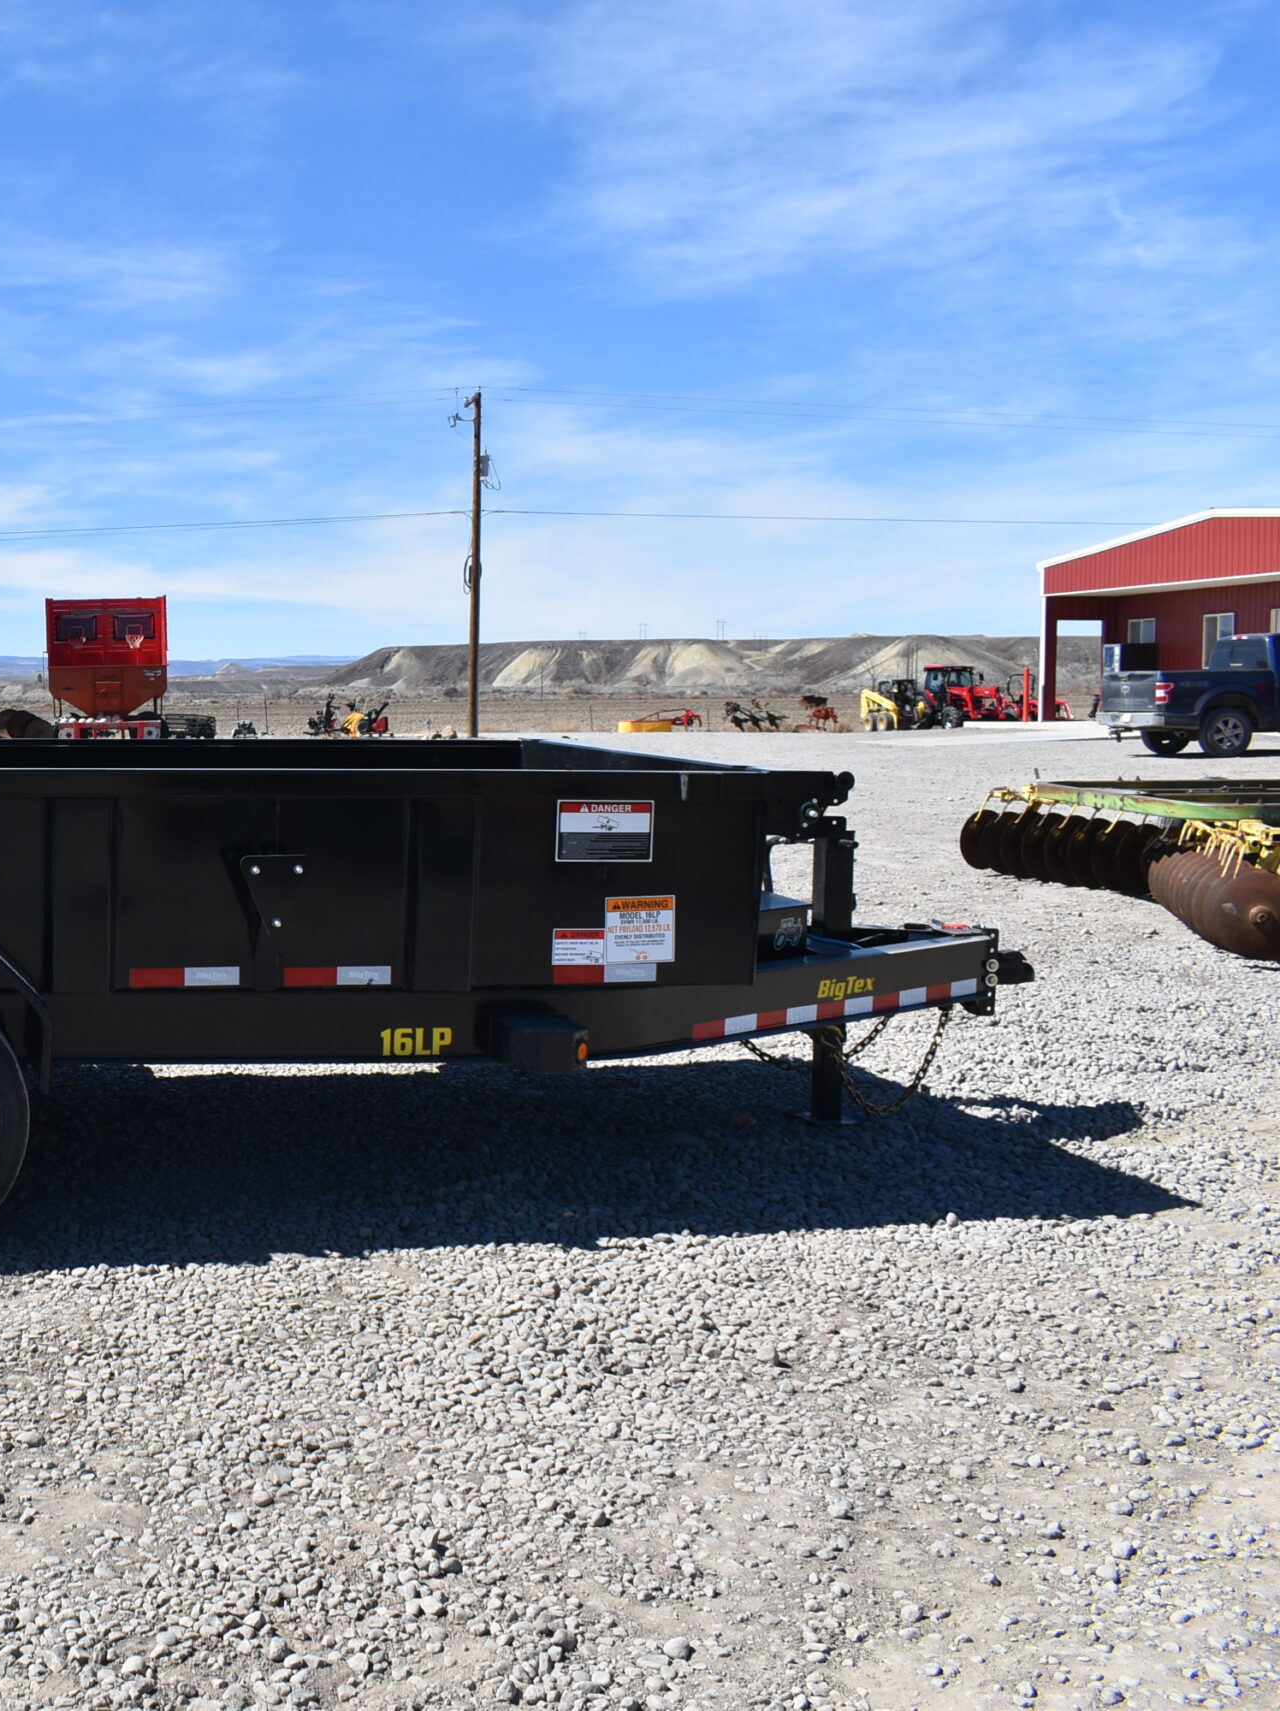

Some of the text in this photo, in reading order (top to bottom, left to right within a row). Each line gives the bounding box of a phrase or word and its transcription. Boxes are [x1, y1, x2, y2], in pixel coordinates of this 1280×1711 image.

[591, 804, 632, 812] DANGER
[621, 899, 669, 909] WARNING
[619, 911, 661, 919] MODEL 16LP
[608, 925, 618, 933] NET
[619, 925, 643, 933] PAYLOAD
[817, 976, 876, 1001] BigTex
[380, 1027, 452, 1056] 16LP
